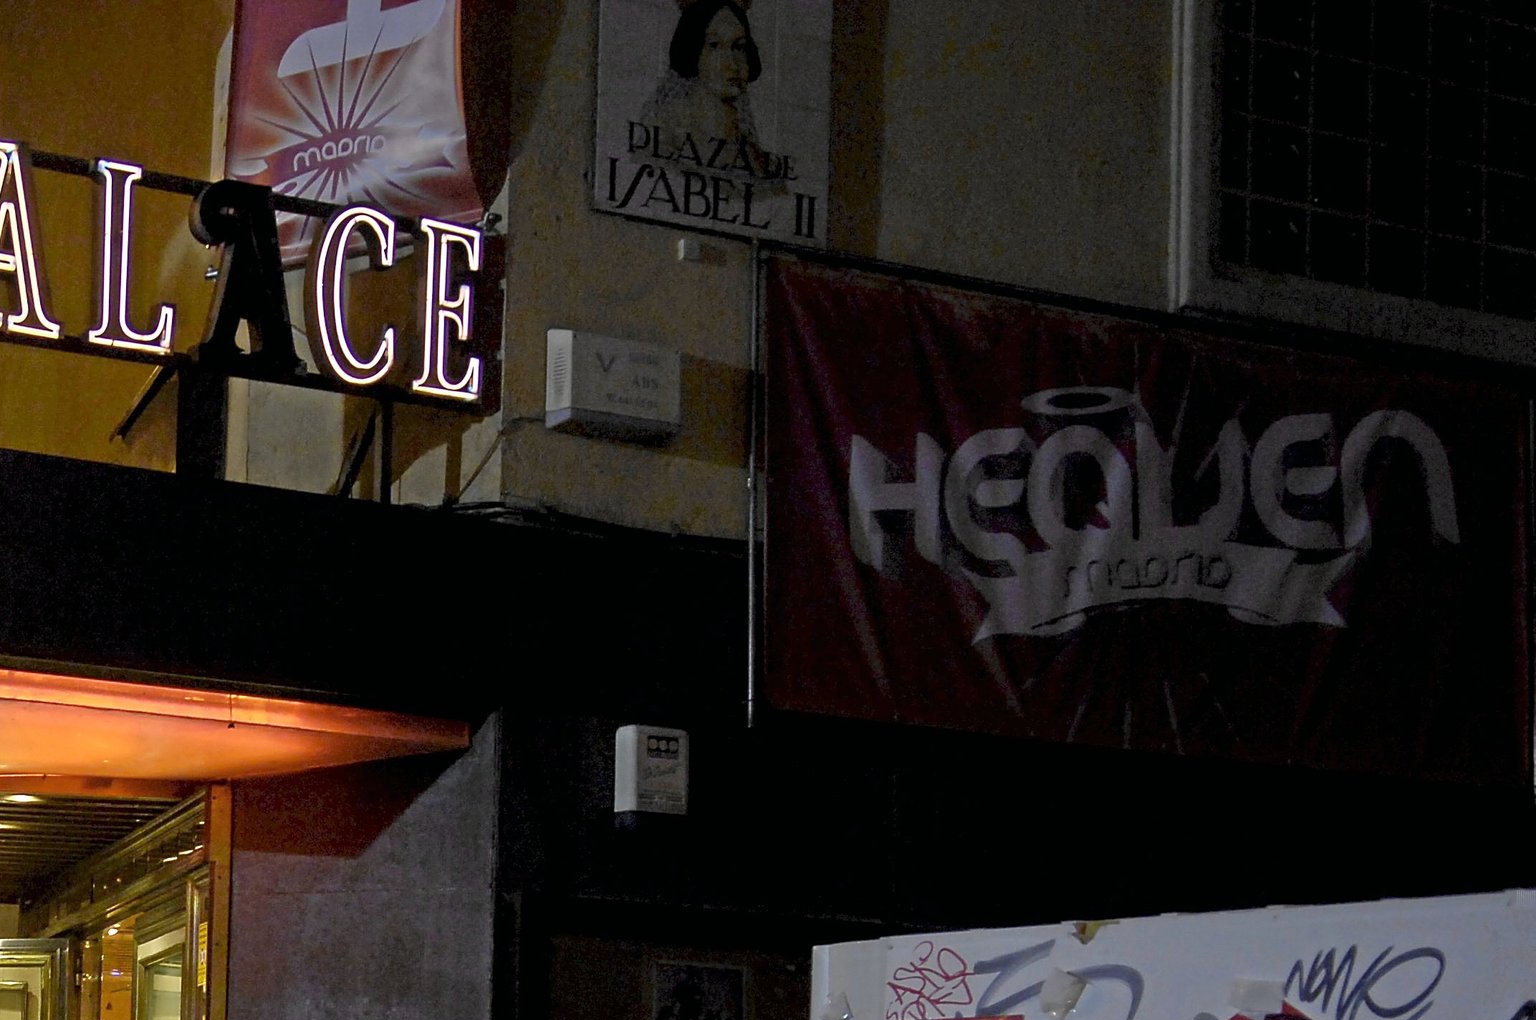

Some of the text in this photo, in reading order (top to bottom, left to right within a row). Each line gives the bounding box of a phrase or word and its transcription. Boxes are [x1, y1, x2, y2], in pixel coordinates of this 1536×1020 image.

[627, 121, 797, 180] PLAZA DE
[608, 157, 818, 239] ISABEL II
